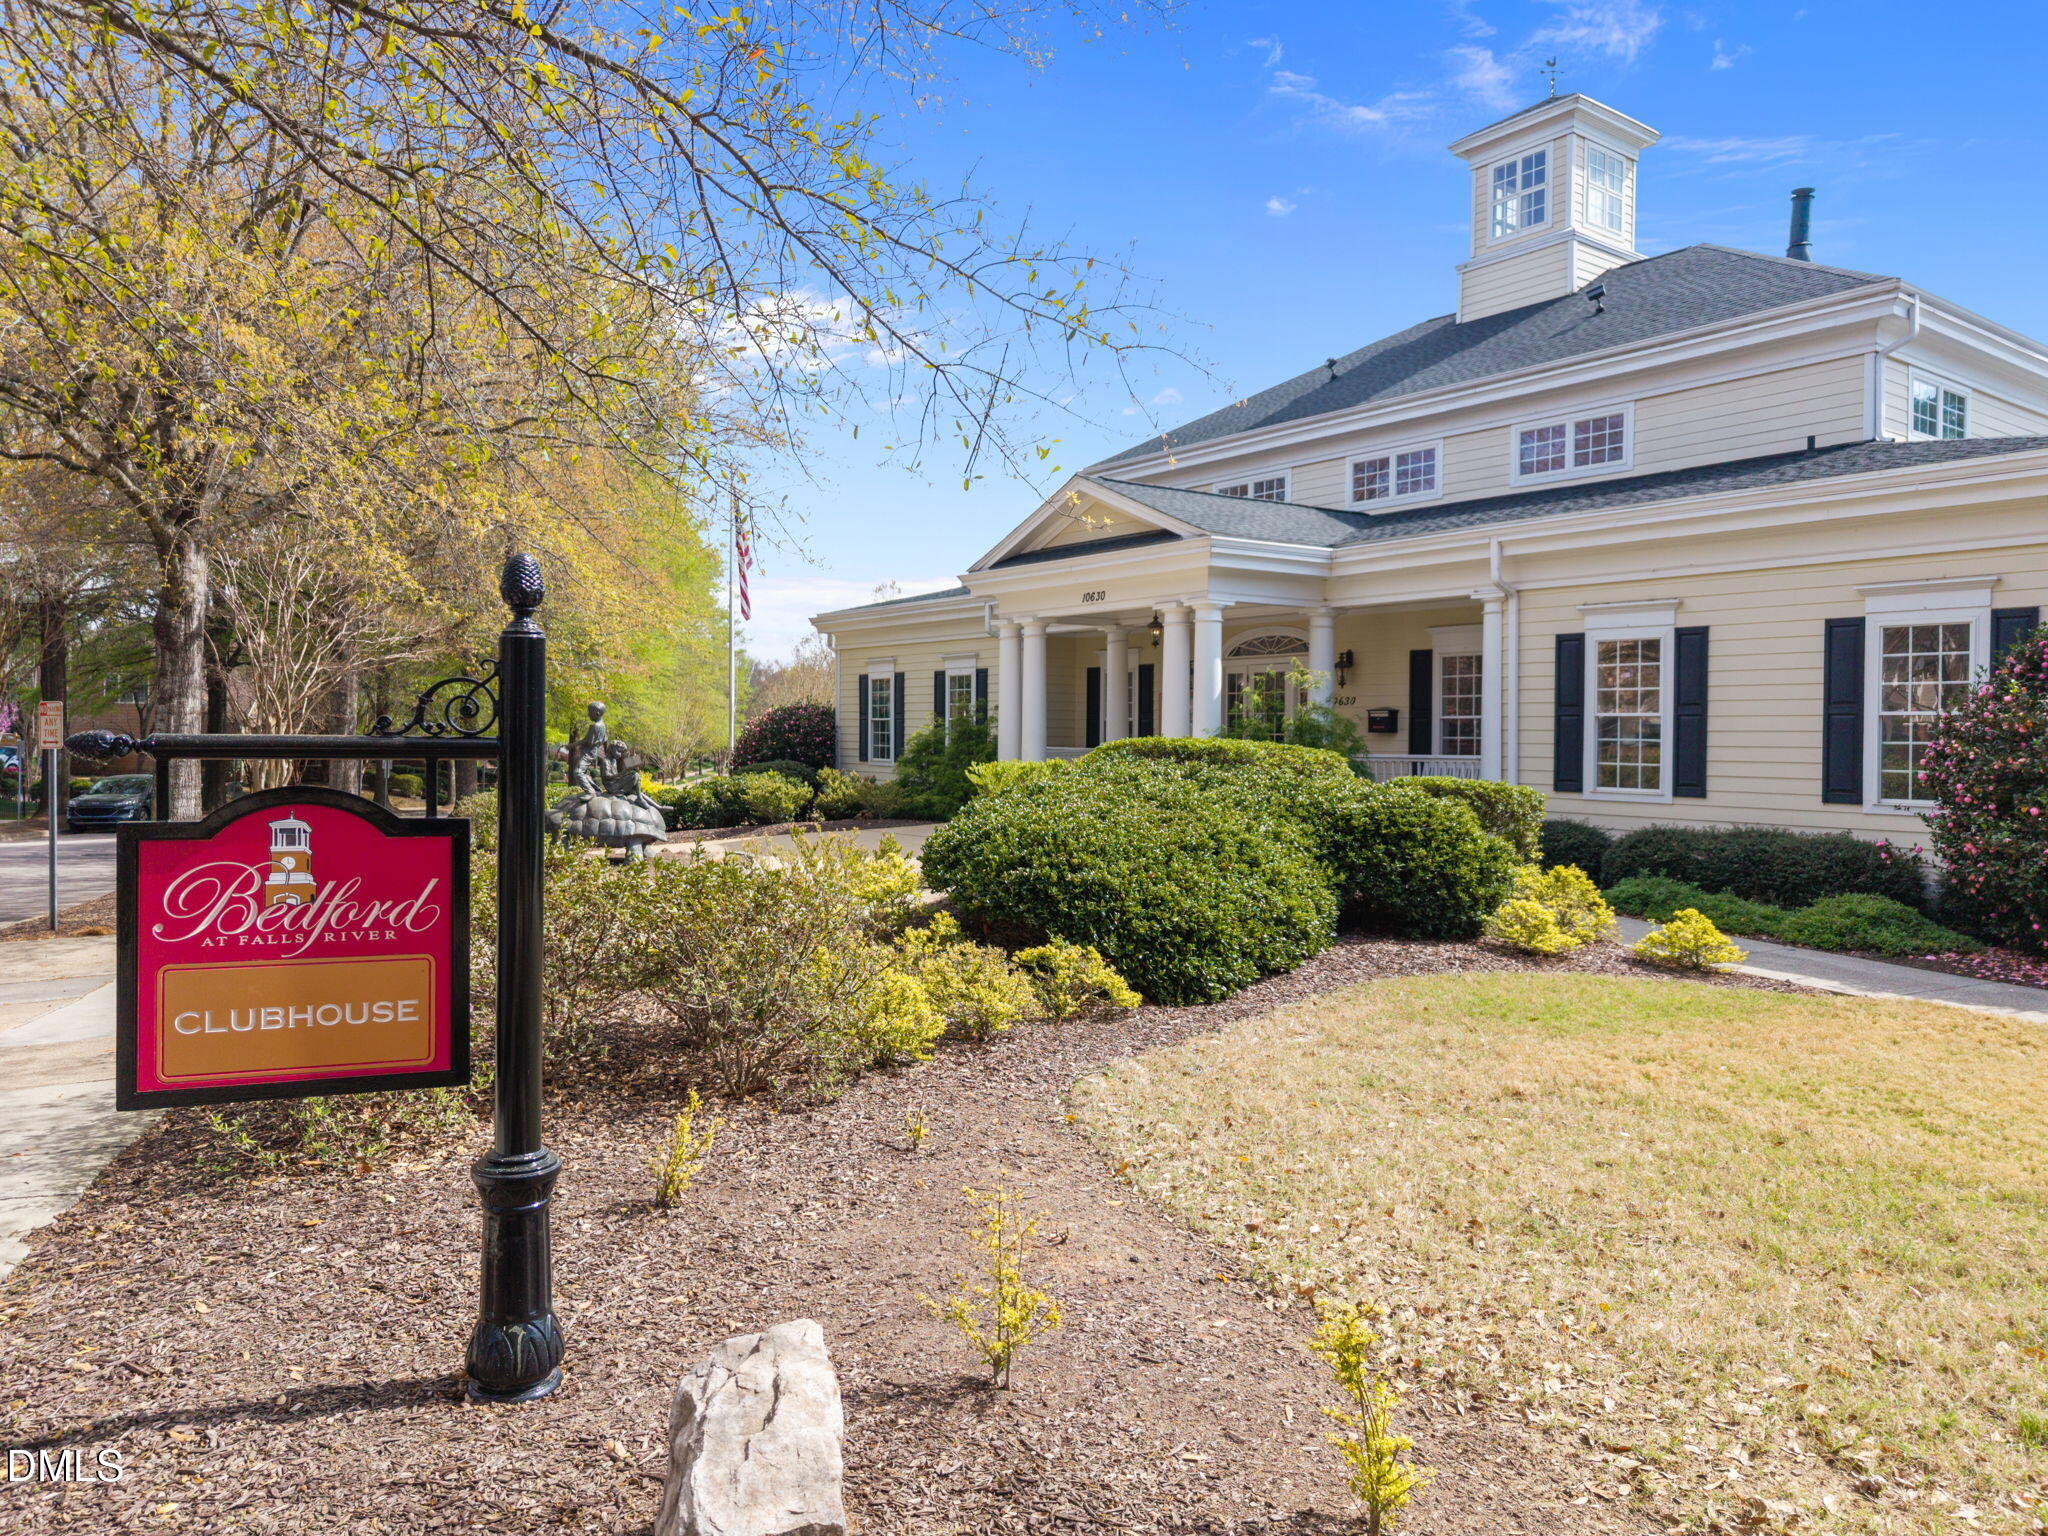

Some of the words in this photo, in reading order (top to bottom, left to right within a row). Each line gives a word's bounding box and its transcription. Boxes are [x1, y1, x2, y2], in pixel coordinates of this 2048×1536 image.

[1082, 591, 1106, 603] 10630
[45, 718, 58, 727] ANY
[44, 729, 58, 738] TIME
[152, 861, 440, 958] Bedford
[201, 936, 228, 947] AT
[238, 933, 305, 945] FALLS
[324, 930, 398, 942] RIVER
[174, 999, 420, 1035] CLUBHOUSE
